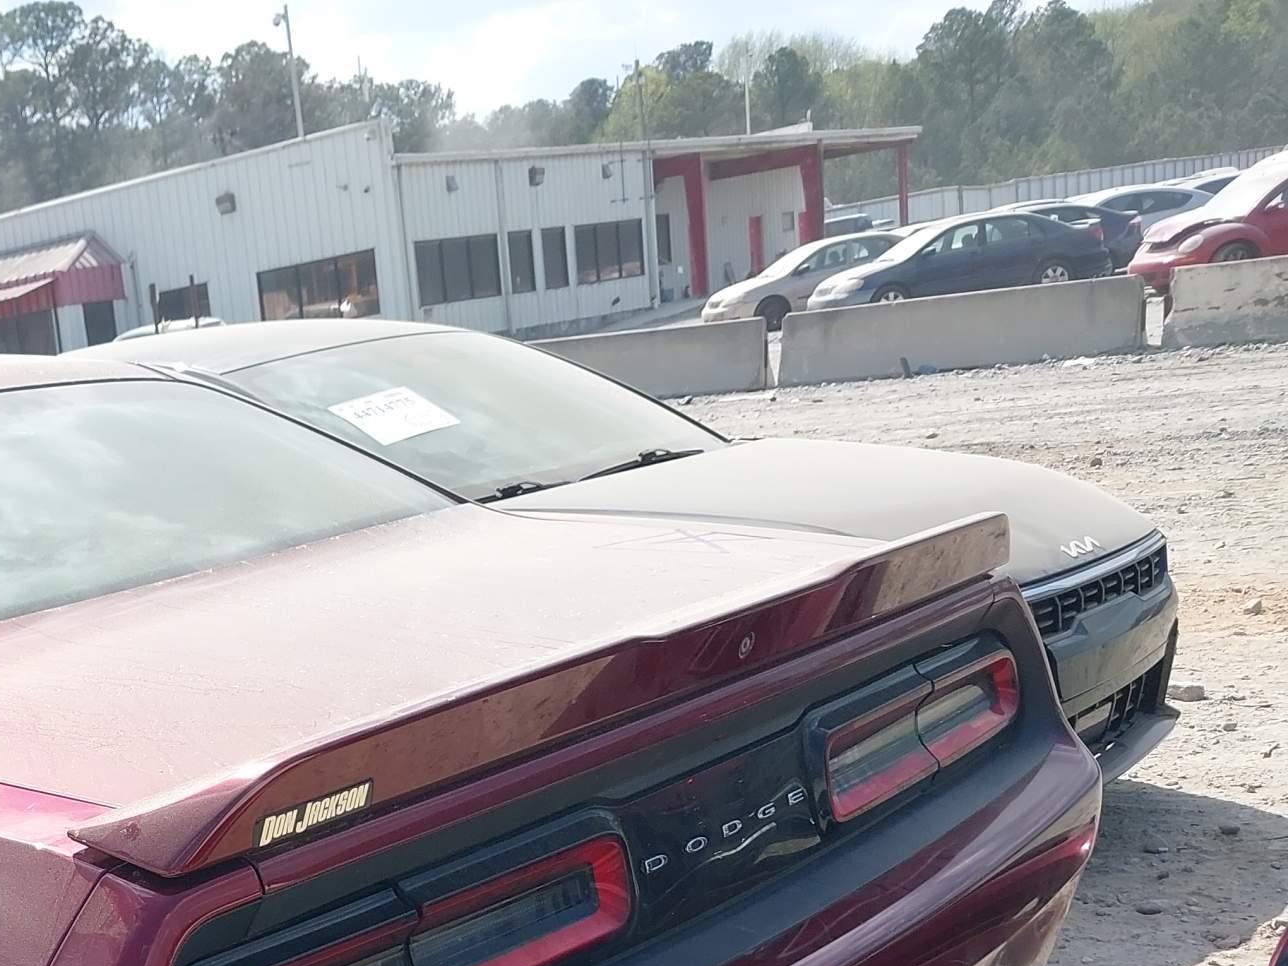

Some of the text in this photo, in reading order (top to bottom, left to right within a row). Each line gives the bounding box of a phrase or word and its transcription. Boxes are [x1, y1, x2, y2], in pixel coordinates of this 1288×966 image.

[259, 783, 369, 847] DON JACKSON
[644, 788, 805, 874] DODGE
